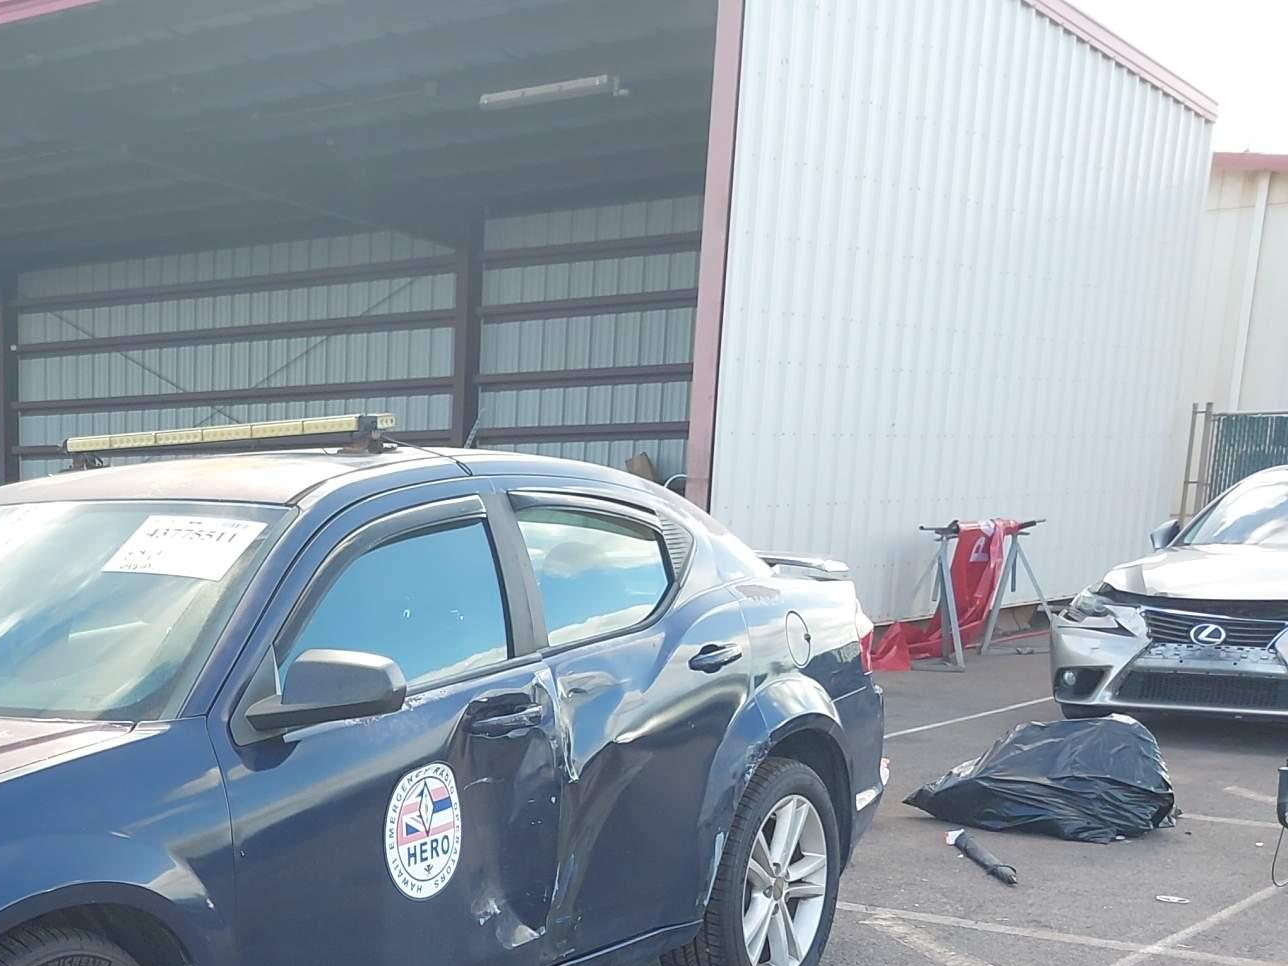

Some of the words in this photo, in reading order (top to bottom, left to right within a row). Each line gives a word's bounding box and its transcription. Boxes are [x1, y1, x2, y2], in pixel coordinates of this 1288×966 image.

[433, 766, 455, 794] RADIO
[388, 768, 430, 850] EMERGENCY
[407, 834, 451, 867] HERO
[391, 857, 423, 894] HAWAII
